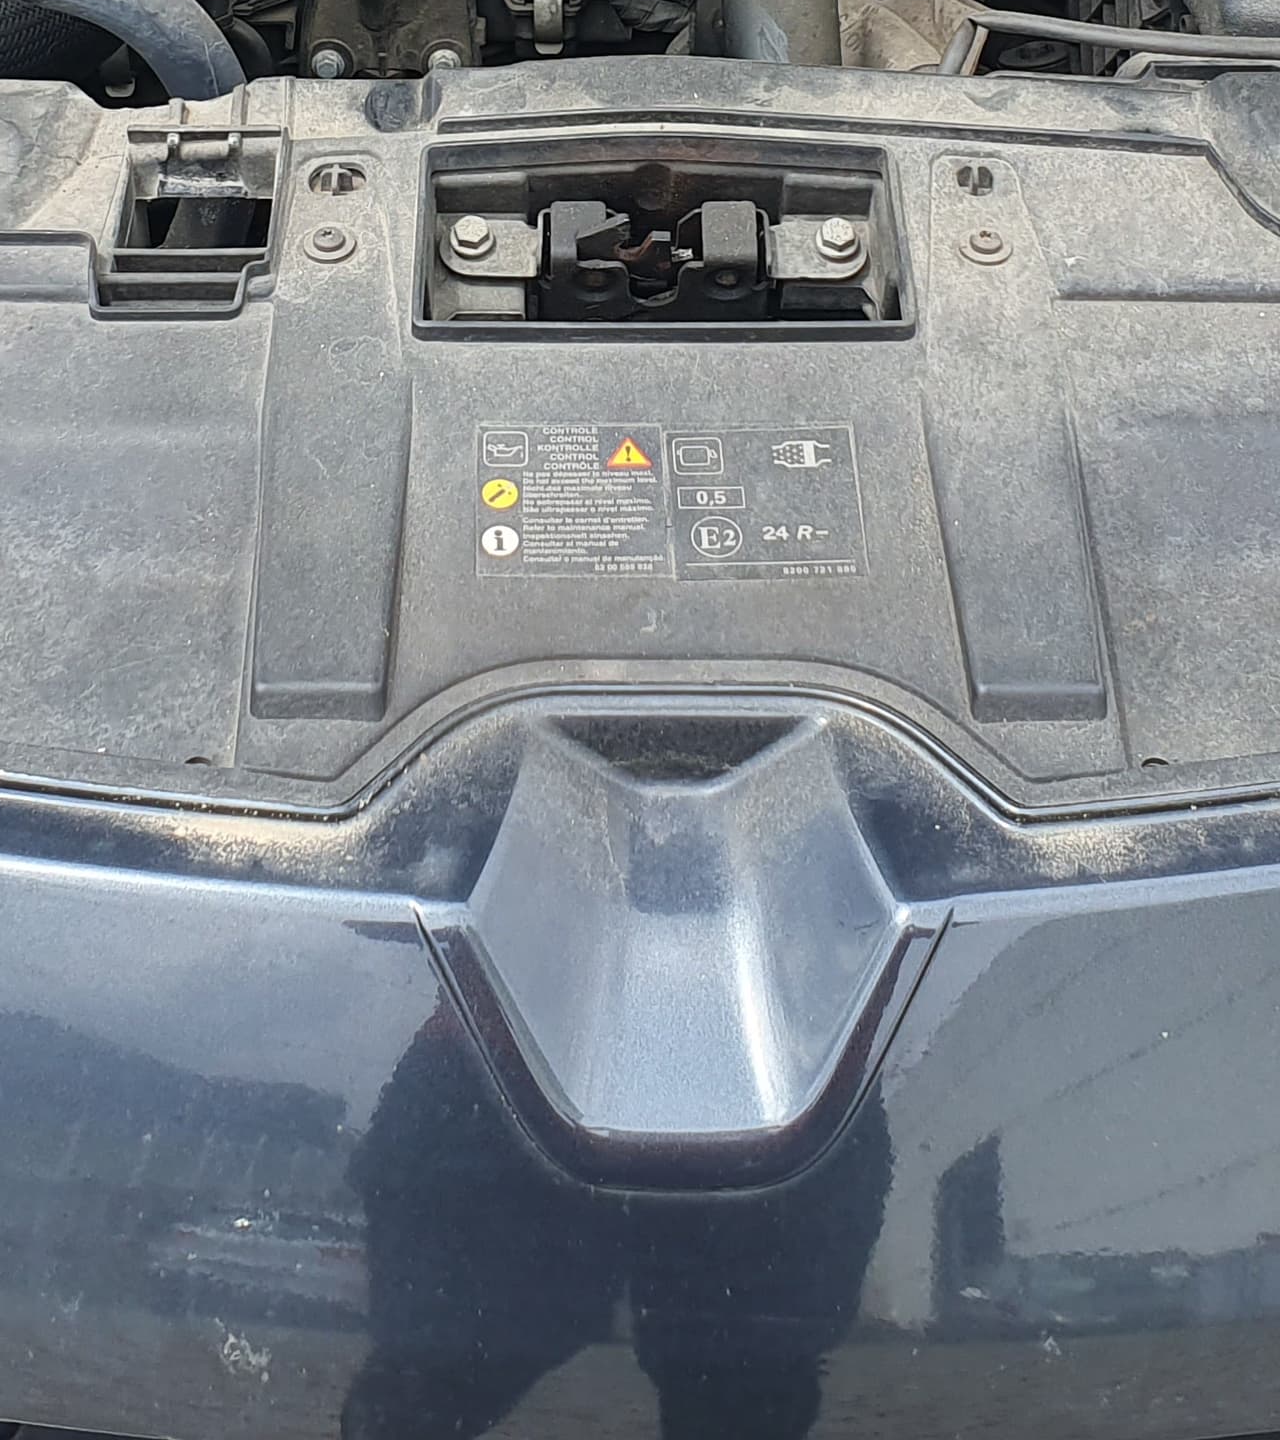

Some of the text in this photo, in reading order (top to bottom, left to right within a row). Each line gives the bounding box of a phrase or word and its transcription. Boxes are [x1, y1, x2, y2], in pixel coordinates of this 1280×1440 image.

[550, 435, 599, 443] CONTROL
[537, 444, 599, 452] KONTROLLE
[550, 453, 600, 461] CONTROL
[695, 490, 727, 506] 0,5
[698, 526, 737, 549] E2
[762, 525, 790, 541] 24
